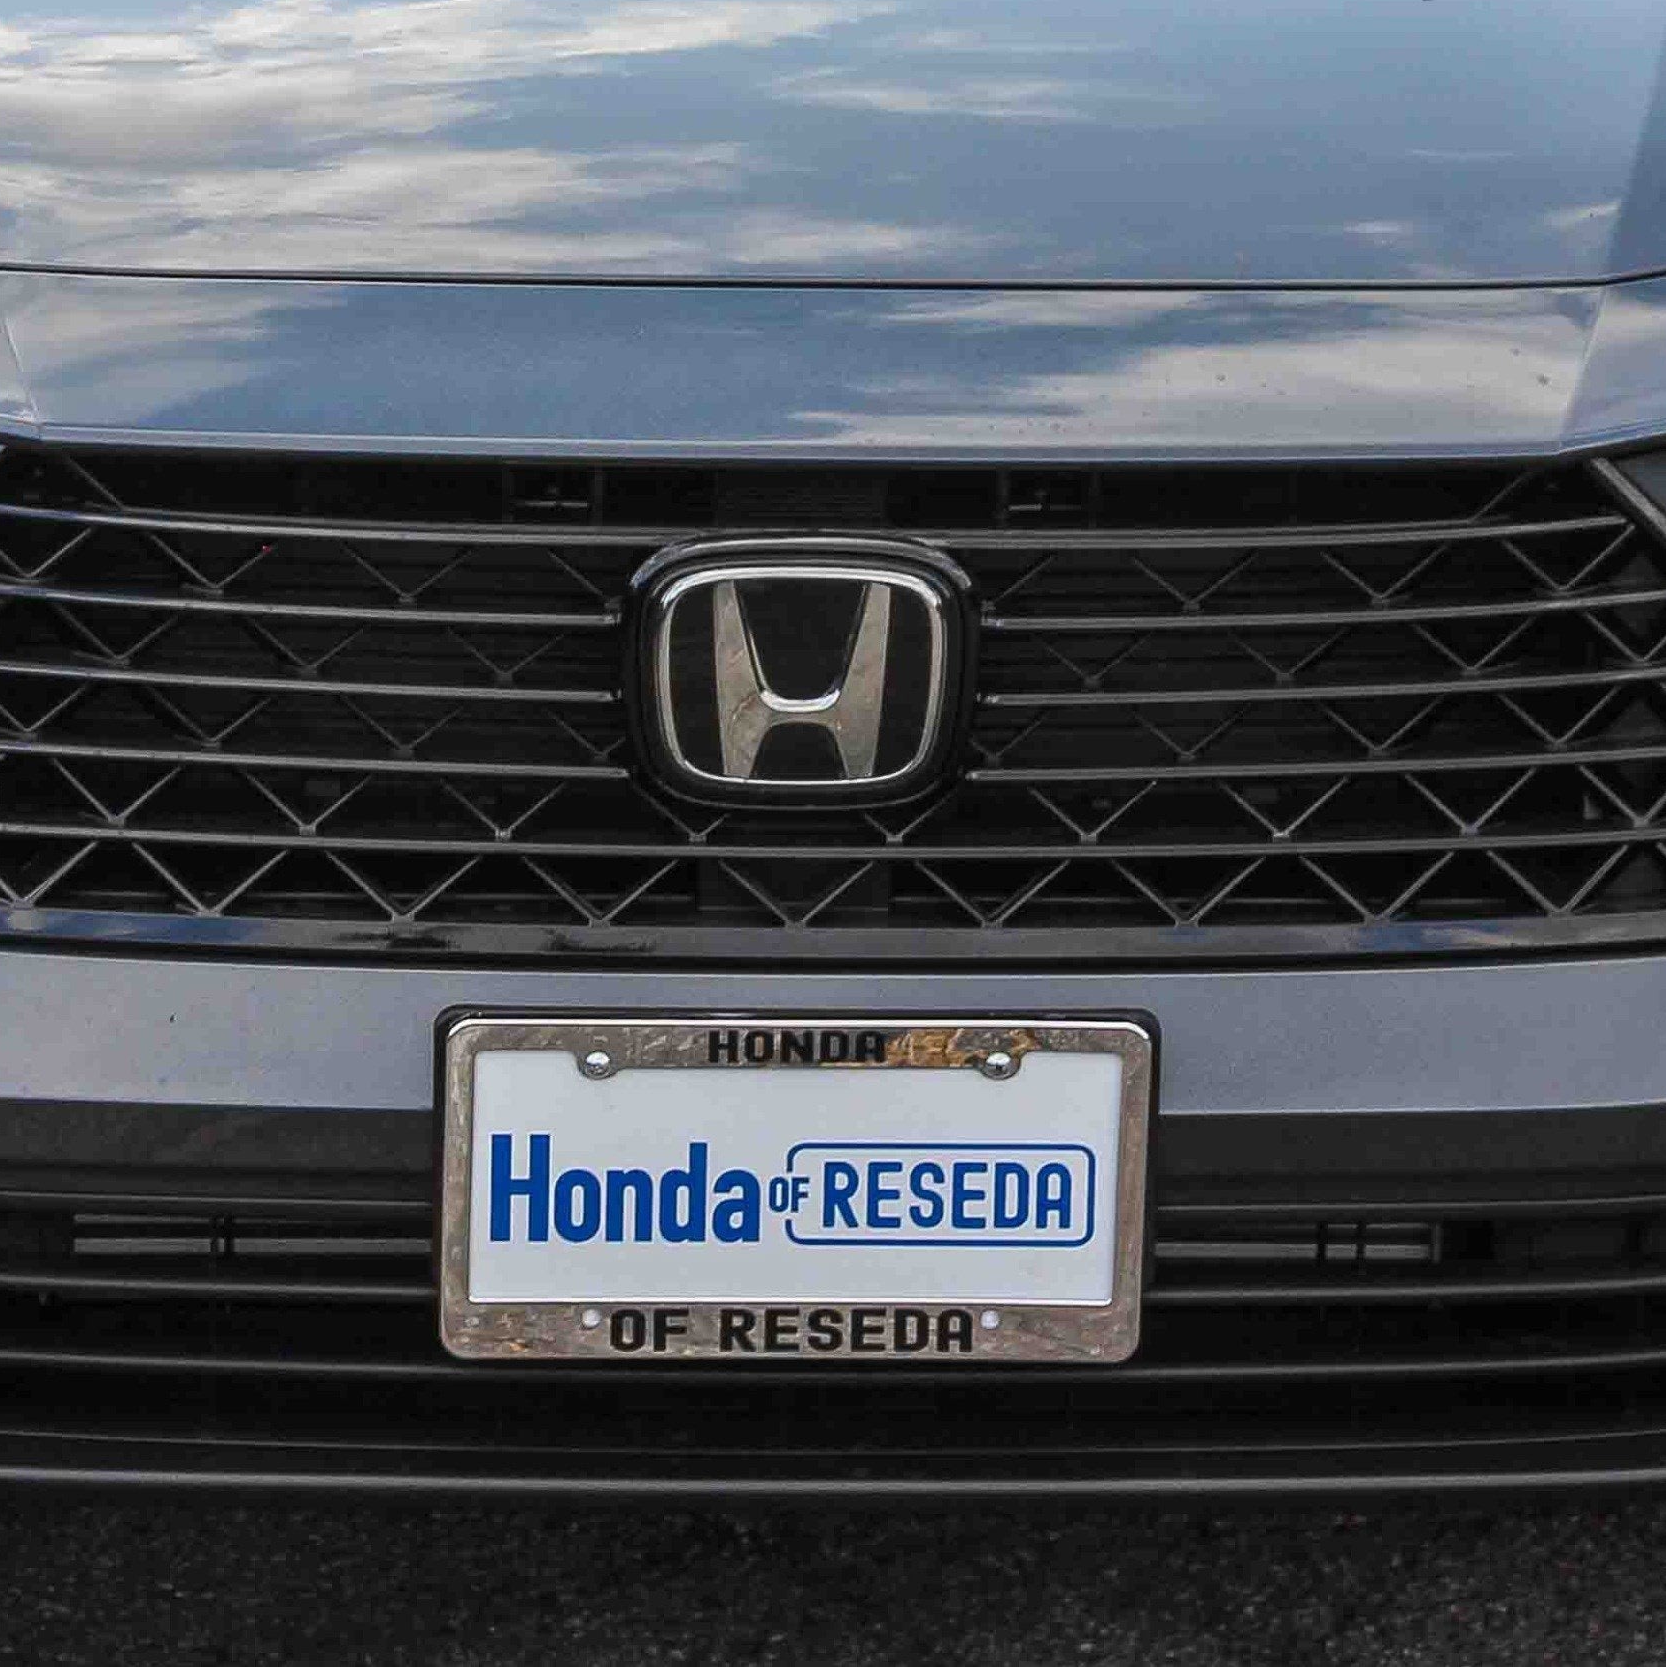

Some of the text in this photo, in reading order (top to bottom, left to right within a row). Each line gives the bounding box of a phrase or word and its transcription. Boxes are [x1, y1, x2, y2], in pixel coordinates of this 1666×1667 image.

[707, 1029, 887, 1063] HONDA
[490, 1133, 1072, 1243] Honda OF RESEDA
[609, 1307, 974, 1353] OF RESEDA
